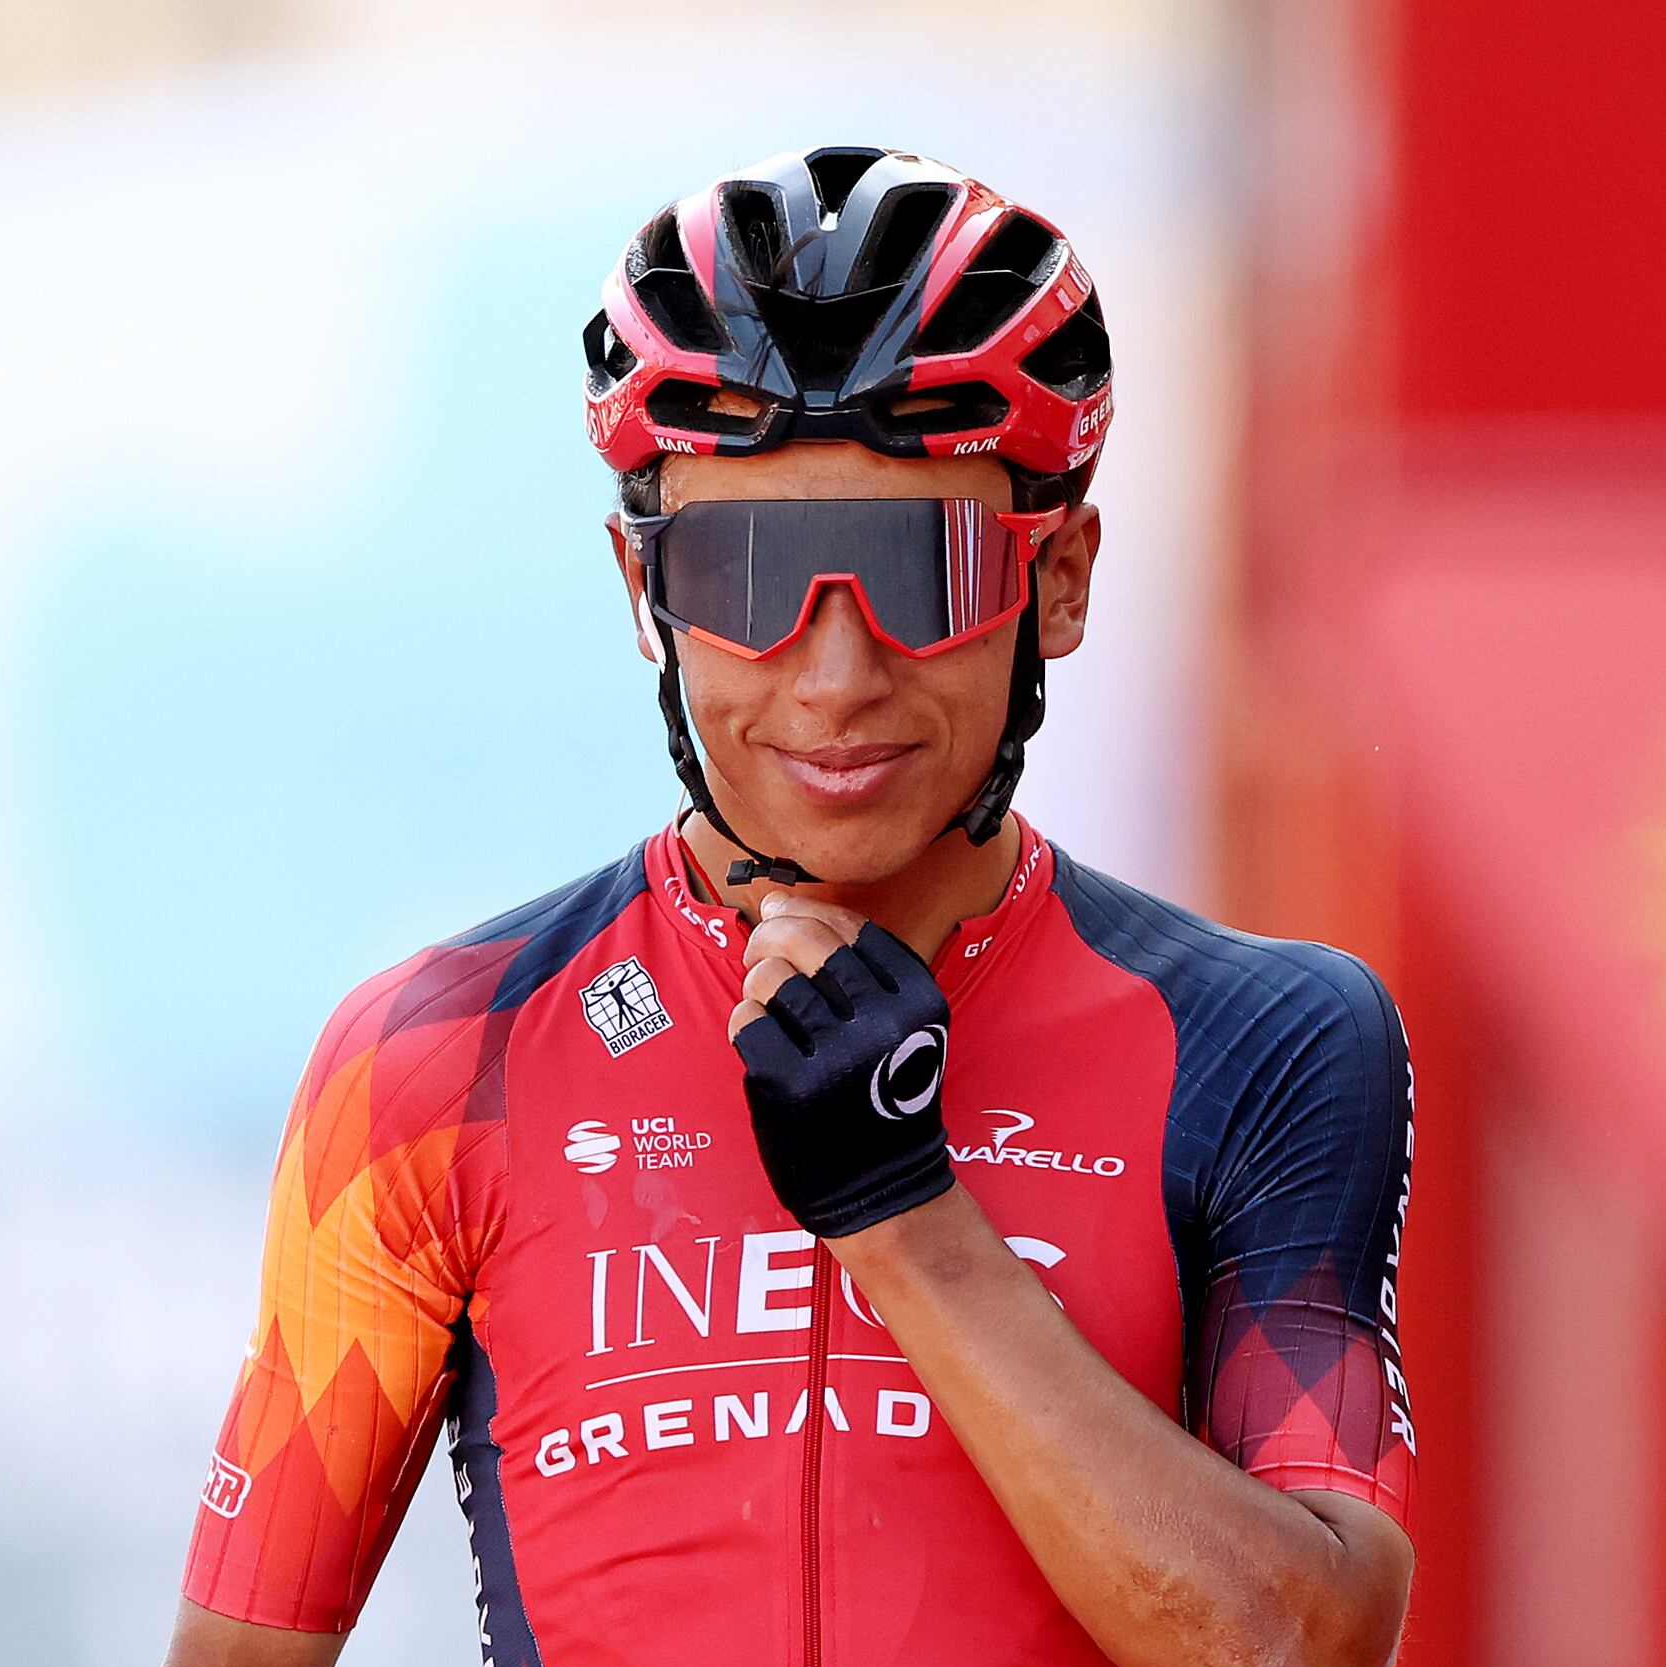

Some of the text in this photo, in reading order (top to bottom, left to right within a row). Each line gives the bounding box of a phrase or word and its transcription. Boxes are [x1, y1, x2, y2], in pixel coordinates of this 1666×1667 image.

[953, 436, 1001, 455] KASK
[609, 1013, 670, 1055] BIORACER
[631, 1117, 675, 1134] UCI
[634, 1133, 711, 1151] WORLD
[635, 1151, 693, 1170] TEAM
[946, 1144, 1125, 1177] NARELLO
[535, 1388, 931, 1478] GRENAD
